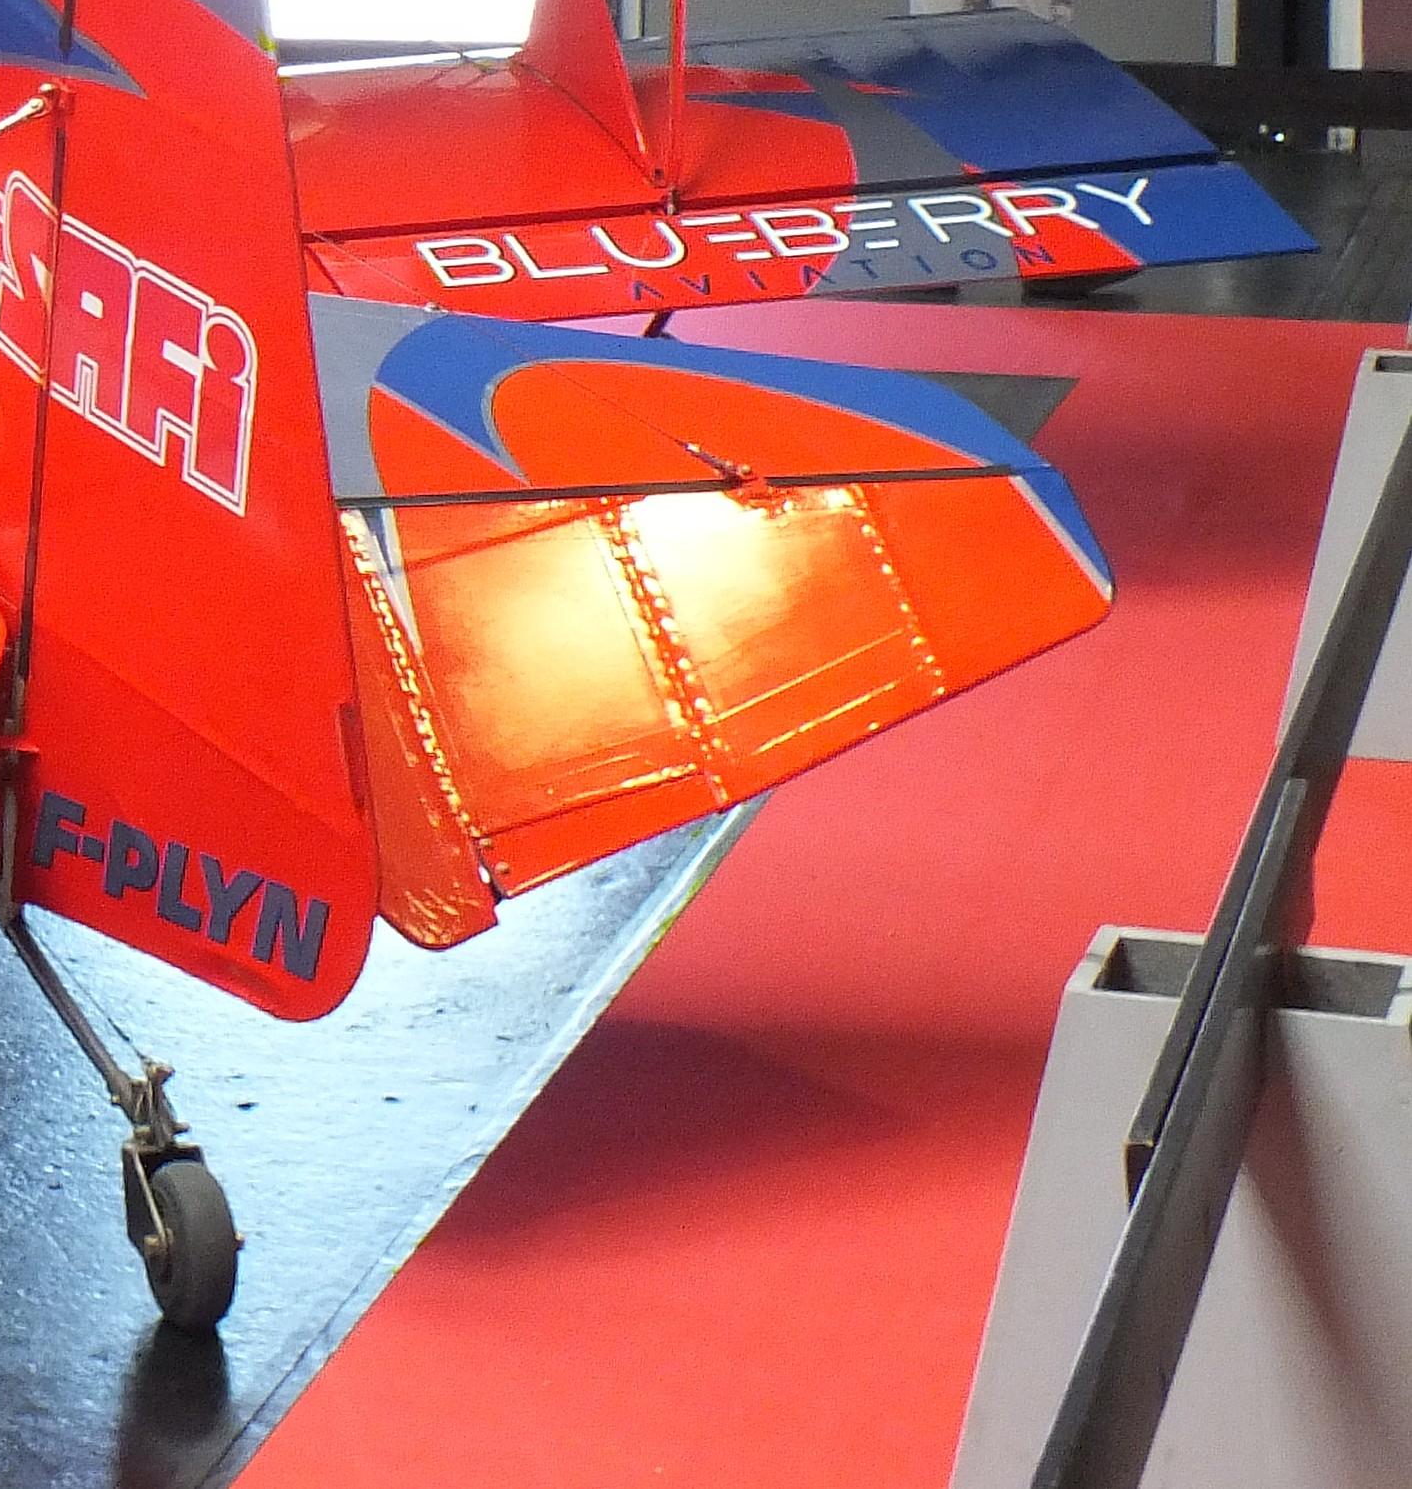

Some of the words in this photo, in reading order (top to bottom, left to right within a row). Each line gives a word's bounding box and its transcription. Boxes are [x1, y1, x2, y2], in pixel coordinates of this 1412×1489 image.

[415, 178, 1153, 289] BLUEBERRY
[632, 246, 1055, 303] AVIATION
[32, 791, 330, 981] F-PLYN
